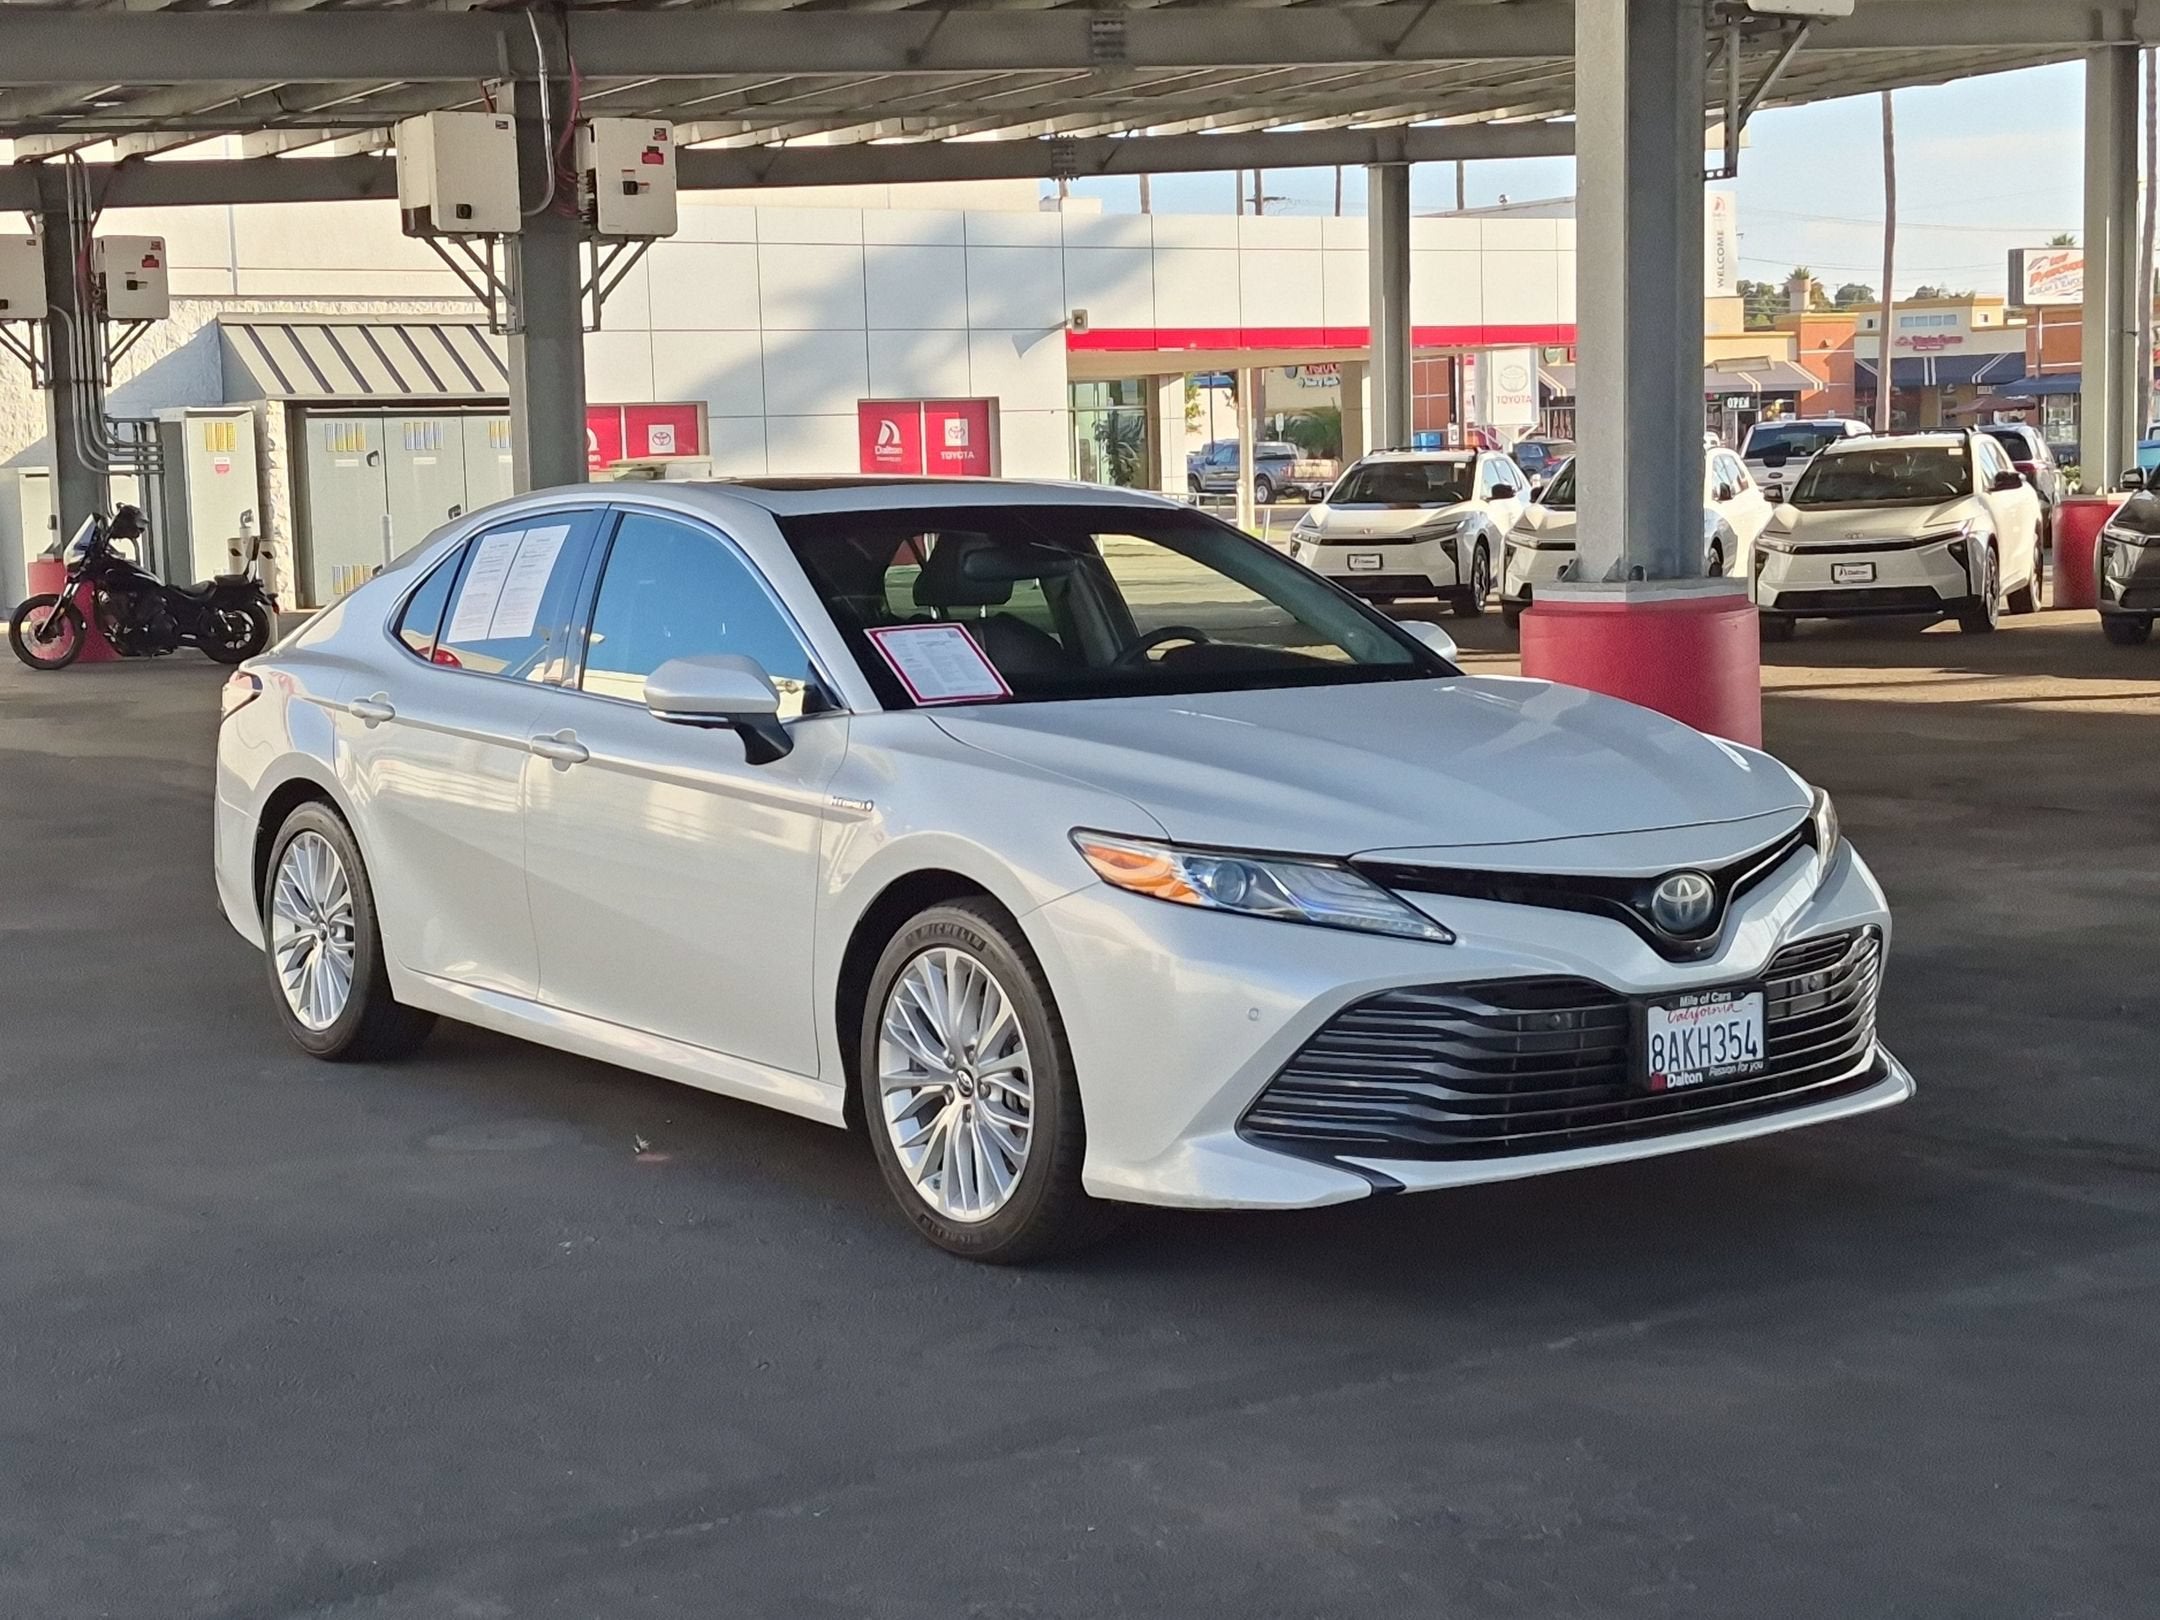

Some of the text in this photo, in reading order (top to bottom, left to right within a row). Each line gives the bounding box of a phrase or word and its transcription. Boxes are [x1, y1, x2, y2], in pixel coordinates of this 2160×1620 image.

[1716, 230, 1726, 289] WELCOME
[1496, 395, 1533, 405] TOYOTA
[1727, 396, 1750, 409] OPEN
[940, 450, 975, 460] TOYOTA
[920, 922, 985, 949] MICHELIN
[1679, 991, 1732, 1007] Mile of Cars
[1667, 1003, 1743, 1025] California
[1651, 1018, 1758, 1073] 8AKH354
[1748, 1060, 1764, 1073] you
[1666, 1071, 1704, 1089] Dalton
